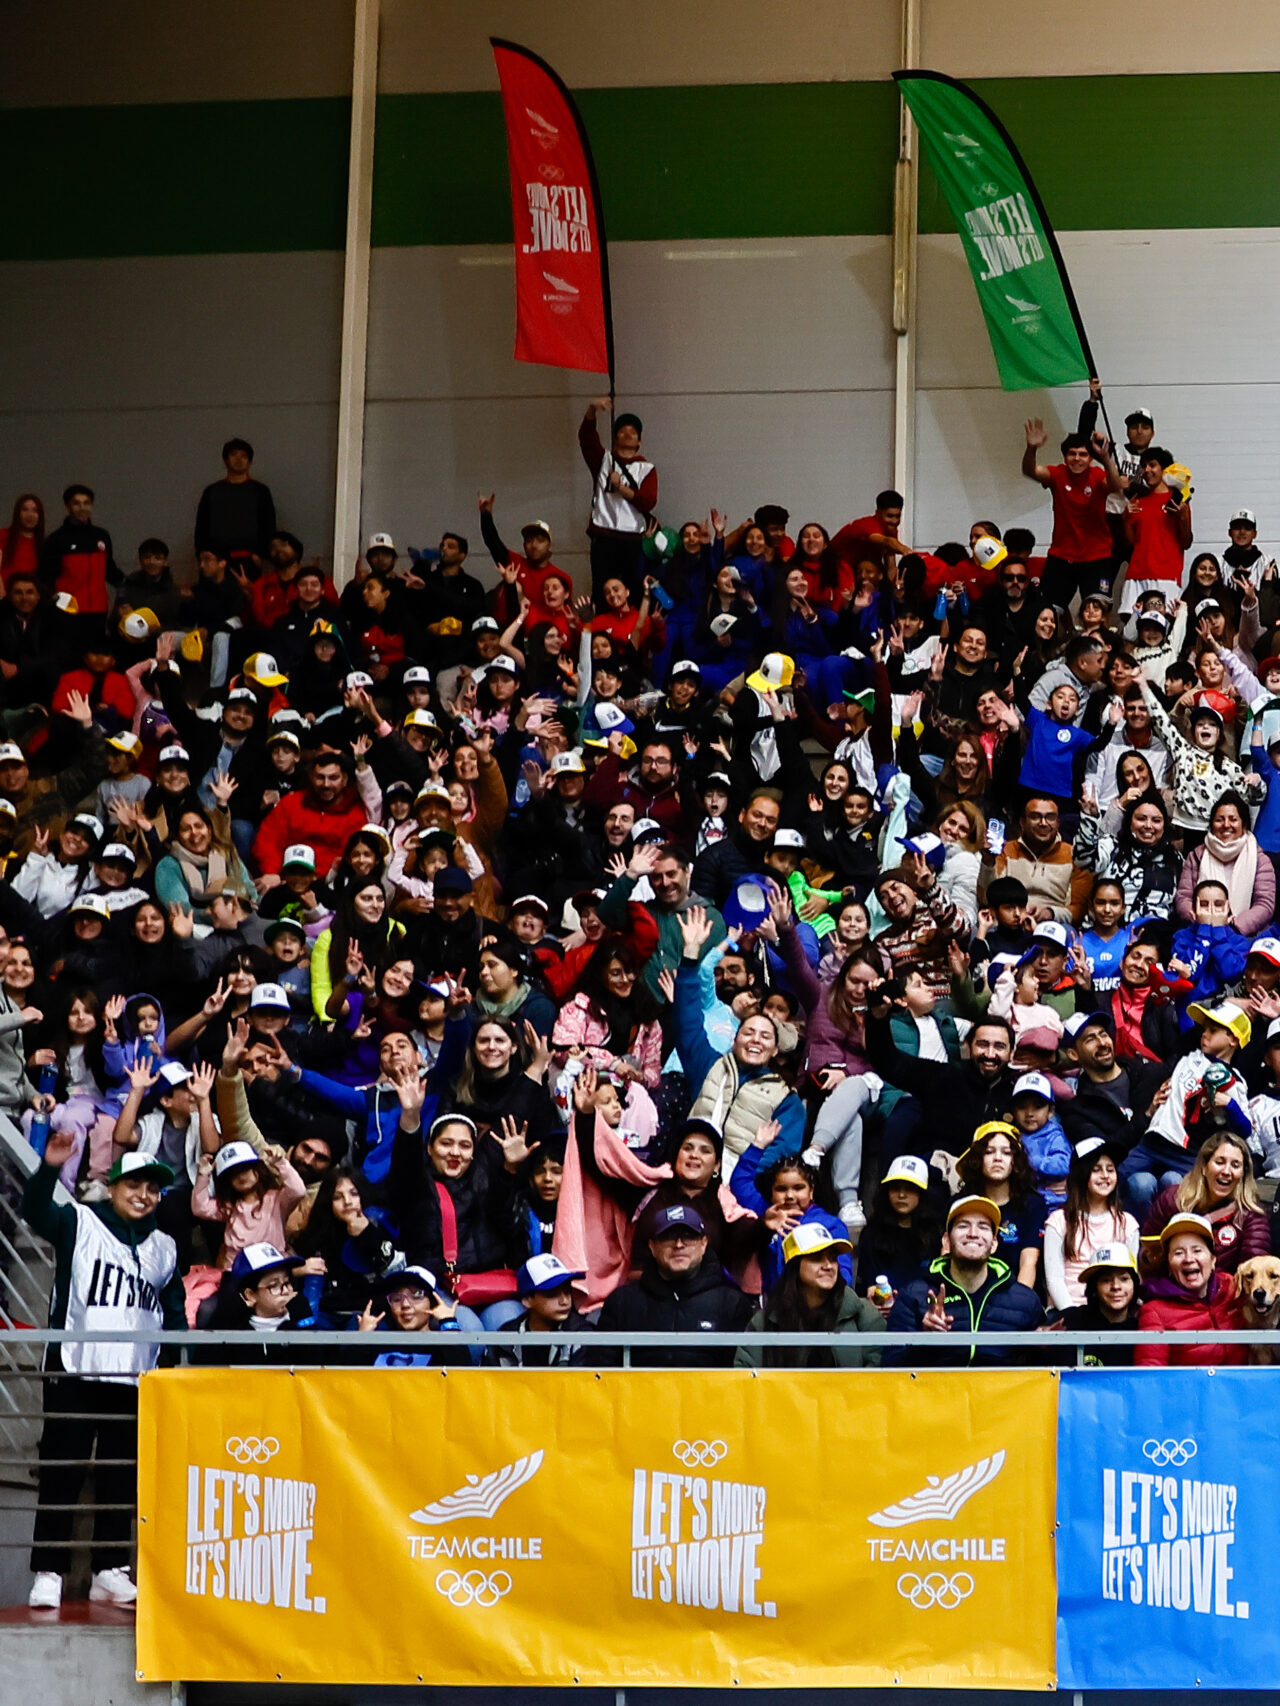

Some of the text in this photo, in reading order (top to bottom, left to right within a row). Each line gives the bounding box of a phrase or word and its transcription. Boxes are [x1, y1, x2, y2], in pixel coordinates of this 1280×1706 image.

[87, 1258, 136, 1309] LET'S
[186, 1465, 316, 1545] LET'S MOVE?
[632, 1468, 767, 1548] LET'S MOVE?
[1103, 1469, 1238, 1549] LET'S MOVE?
[186, 1528, 327, 1614] LET'S MOVE.
[407, 1536, 543, 1560] TEAMCHILE
[632, 1534, 777, 1618] LET'S MOVE.
[867, 1538, 1006, 1562] TEAMCHILE
[1103, 1532, 1250, 1619] LET'S MOVE.
